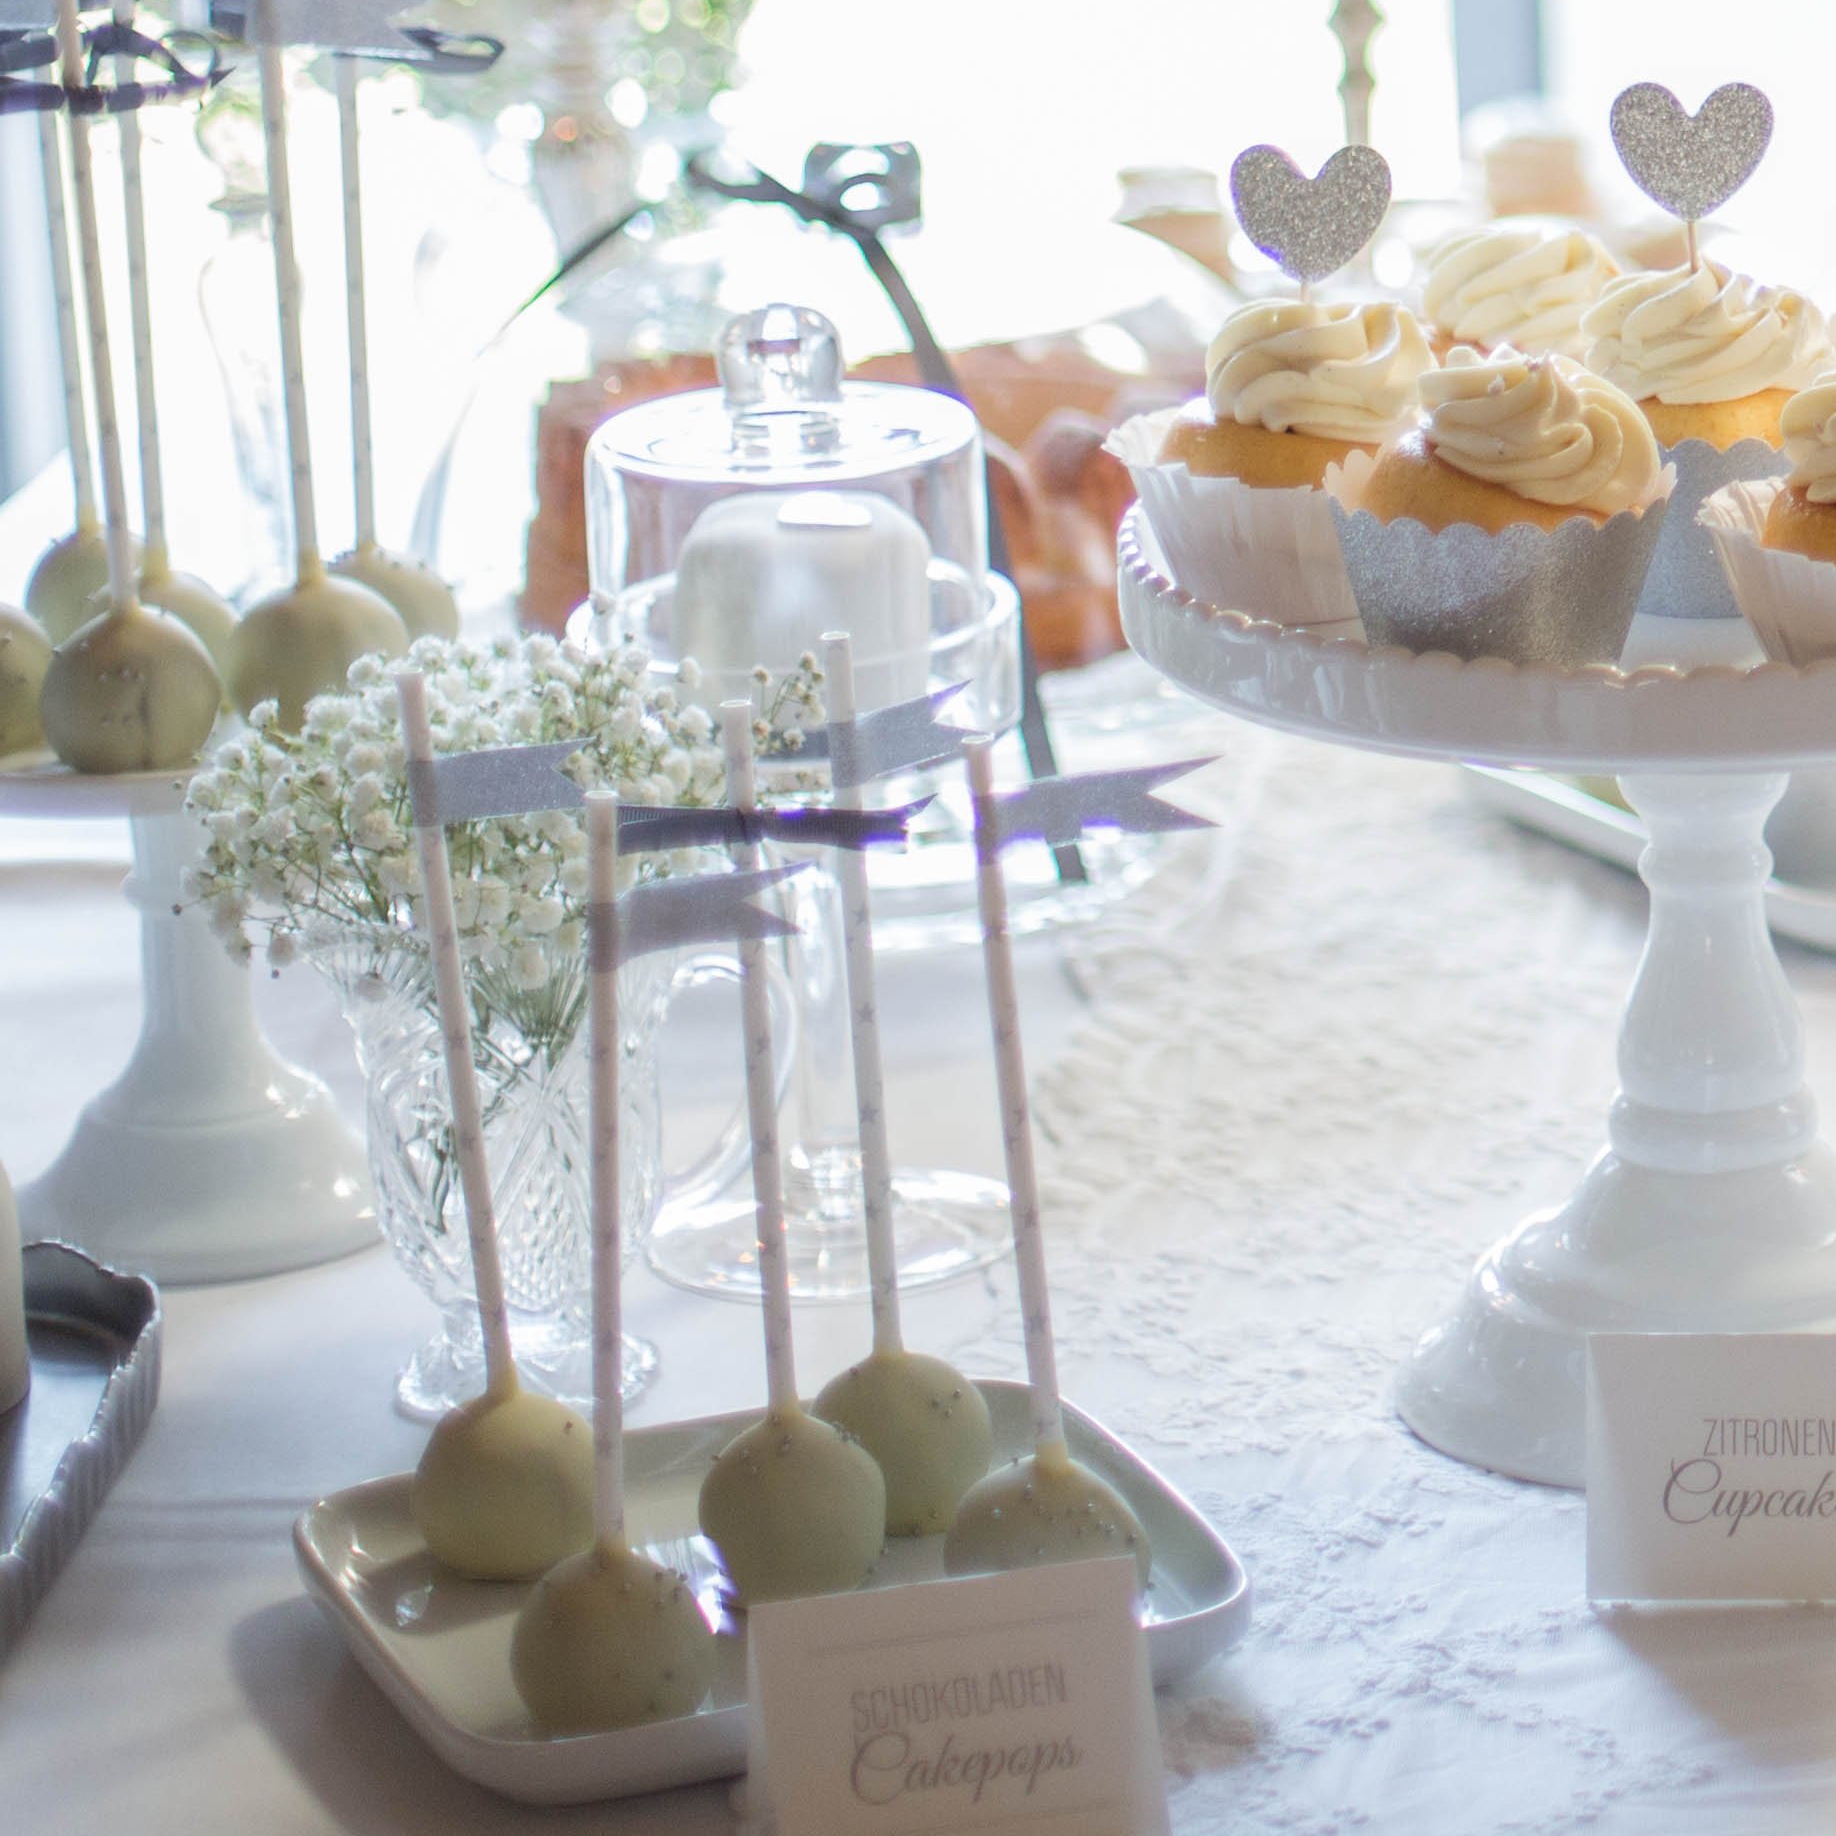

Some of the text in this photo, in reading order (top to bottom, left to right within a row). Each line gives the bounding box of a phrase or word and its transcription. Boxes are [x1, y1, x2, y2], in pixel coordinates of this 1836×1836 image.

[1702, 1418, 1836, 1457] ZITRONEN
[849, 1662, 1069, 1733] SCHOKOLADEN
[849, 1729, 1084, 1806] Cakepops
